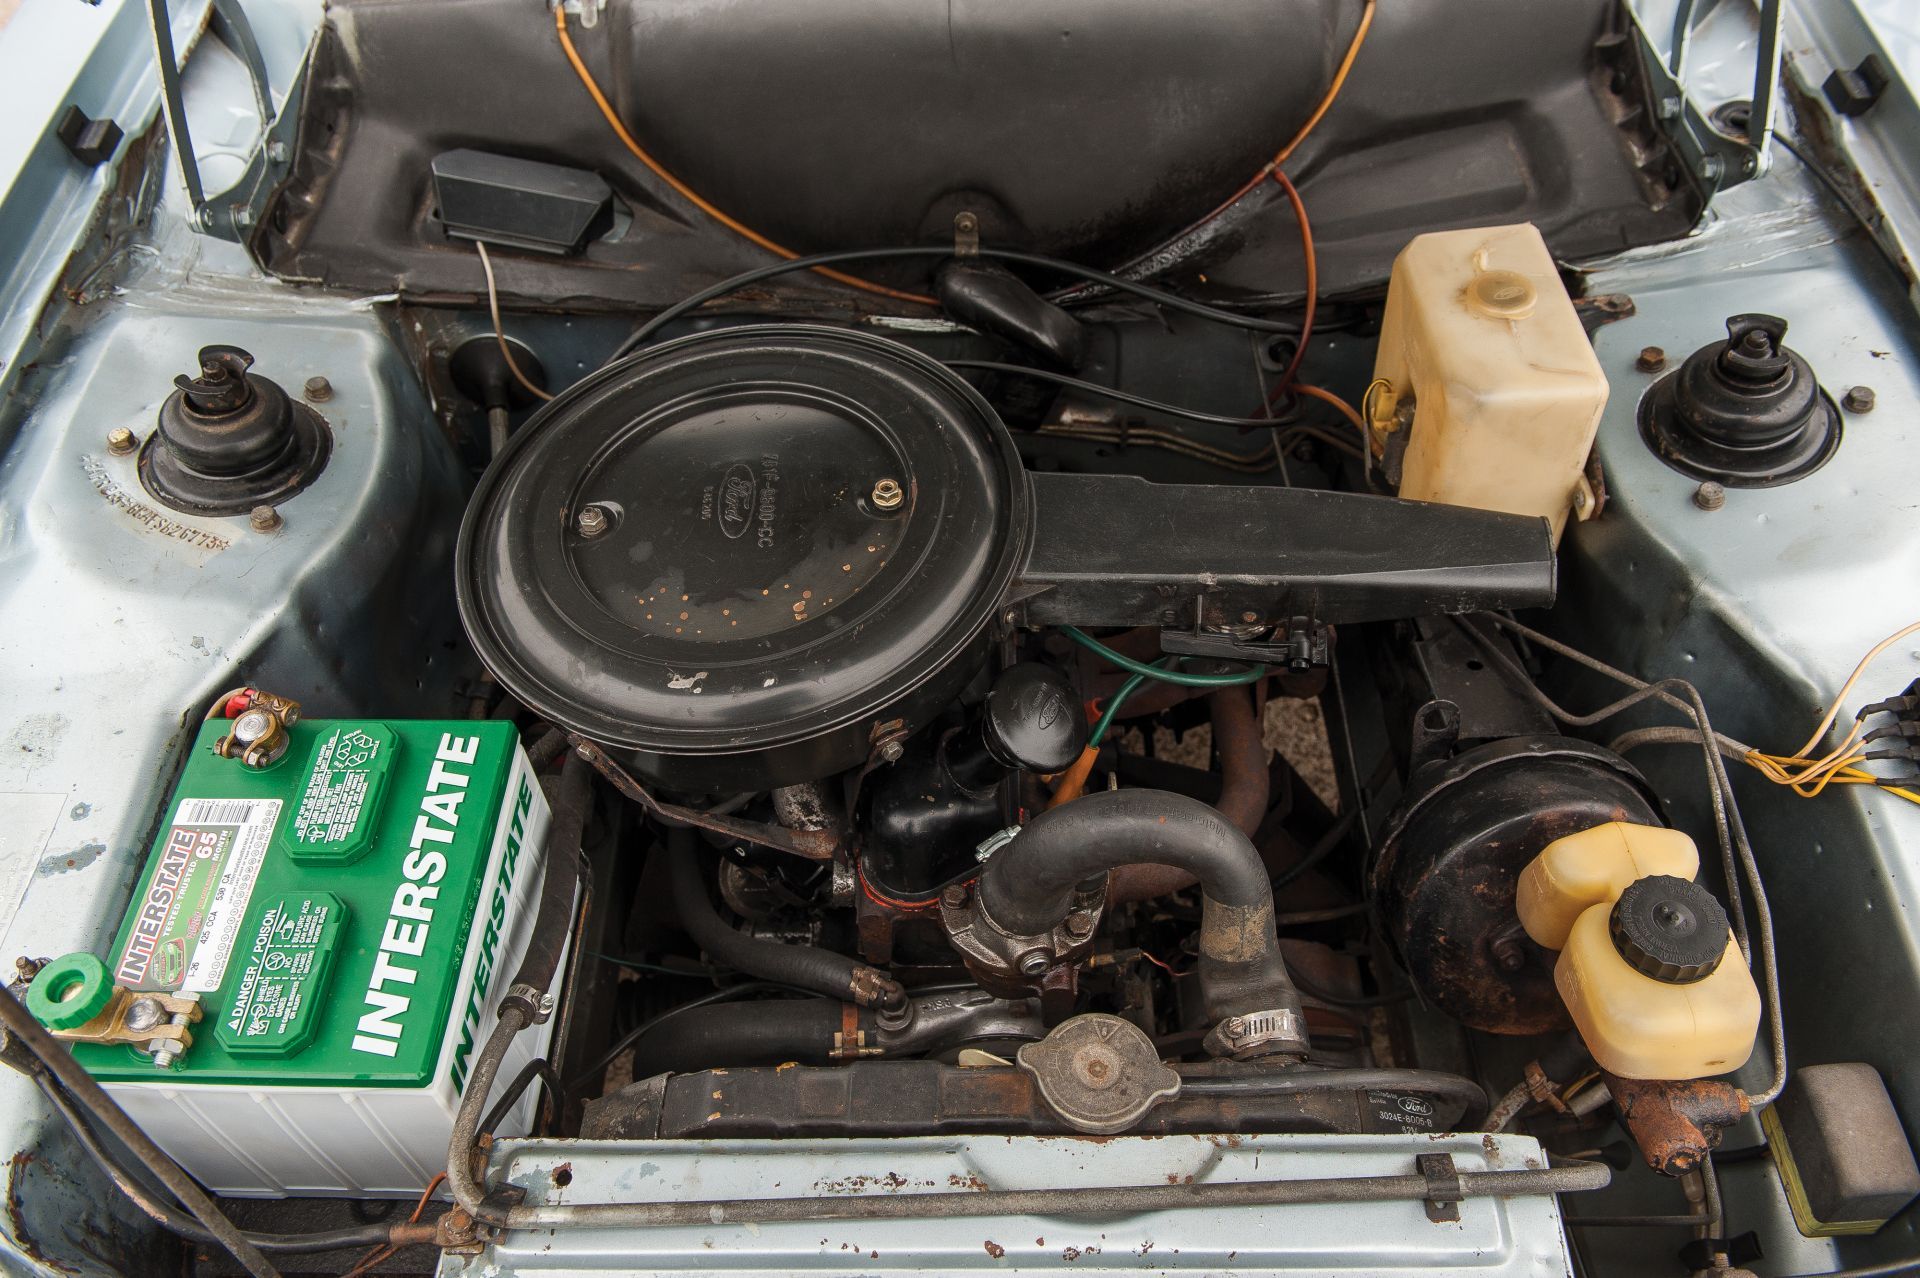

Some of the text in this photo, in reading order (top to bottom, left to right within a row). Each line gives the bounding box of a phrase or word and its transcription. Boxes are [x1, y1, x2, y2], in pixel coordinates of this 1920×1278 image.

[725, 478, 752, 522] Ford
[195, 832, 217, 858] 65
[212, 830, 228, 861] MONTH
[163, 903, 180, 936] TESTED.
[177, 860, 197, 899] TRUSTED.
[215, 873, 231, 900] 530 CA
[352, 733, 479, 1057] INTERSTATE
[117, 828, 197, 983] INTERSTATE
[200, 930, 210, 944] 425
[205, 911, 217, 927] CCA
[291, 900, 310, 943] SULFURIC ACID
[299, 915, 312, 943] CAN CAUSE
[451, 773, 533, 1098] INTERSTATE
[232, 966, 257, 1016] DANGER
[253, 909, 276, 952] POISON
[283, 956, 292, 967] NO
[290, 952, 301, 973] SPARKS
[296, 953, 307, 973] FLAMES
[256, 979, 269, 1001] SHIELD
[264, 986, 274, 1001] EYES
[267, 984, 282, 1017] EXPLOSIVE
[275, 997, 287, 1017] GASES
[281, 1008, 291, 1023] CAUSE
[289, 1011, 296, 1019] OR
[278, 1023, 286, 1033] CAN
